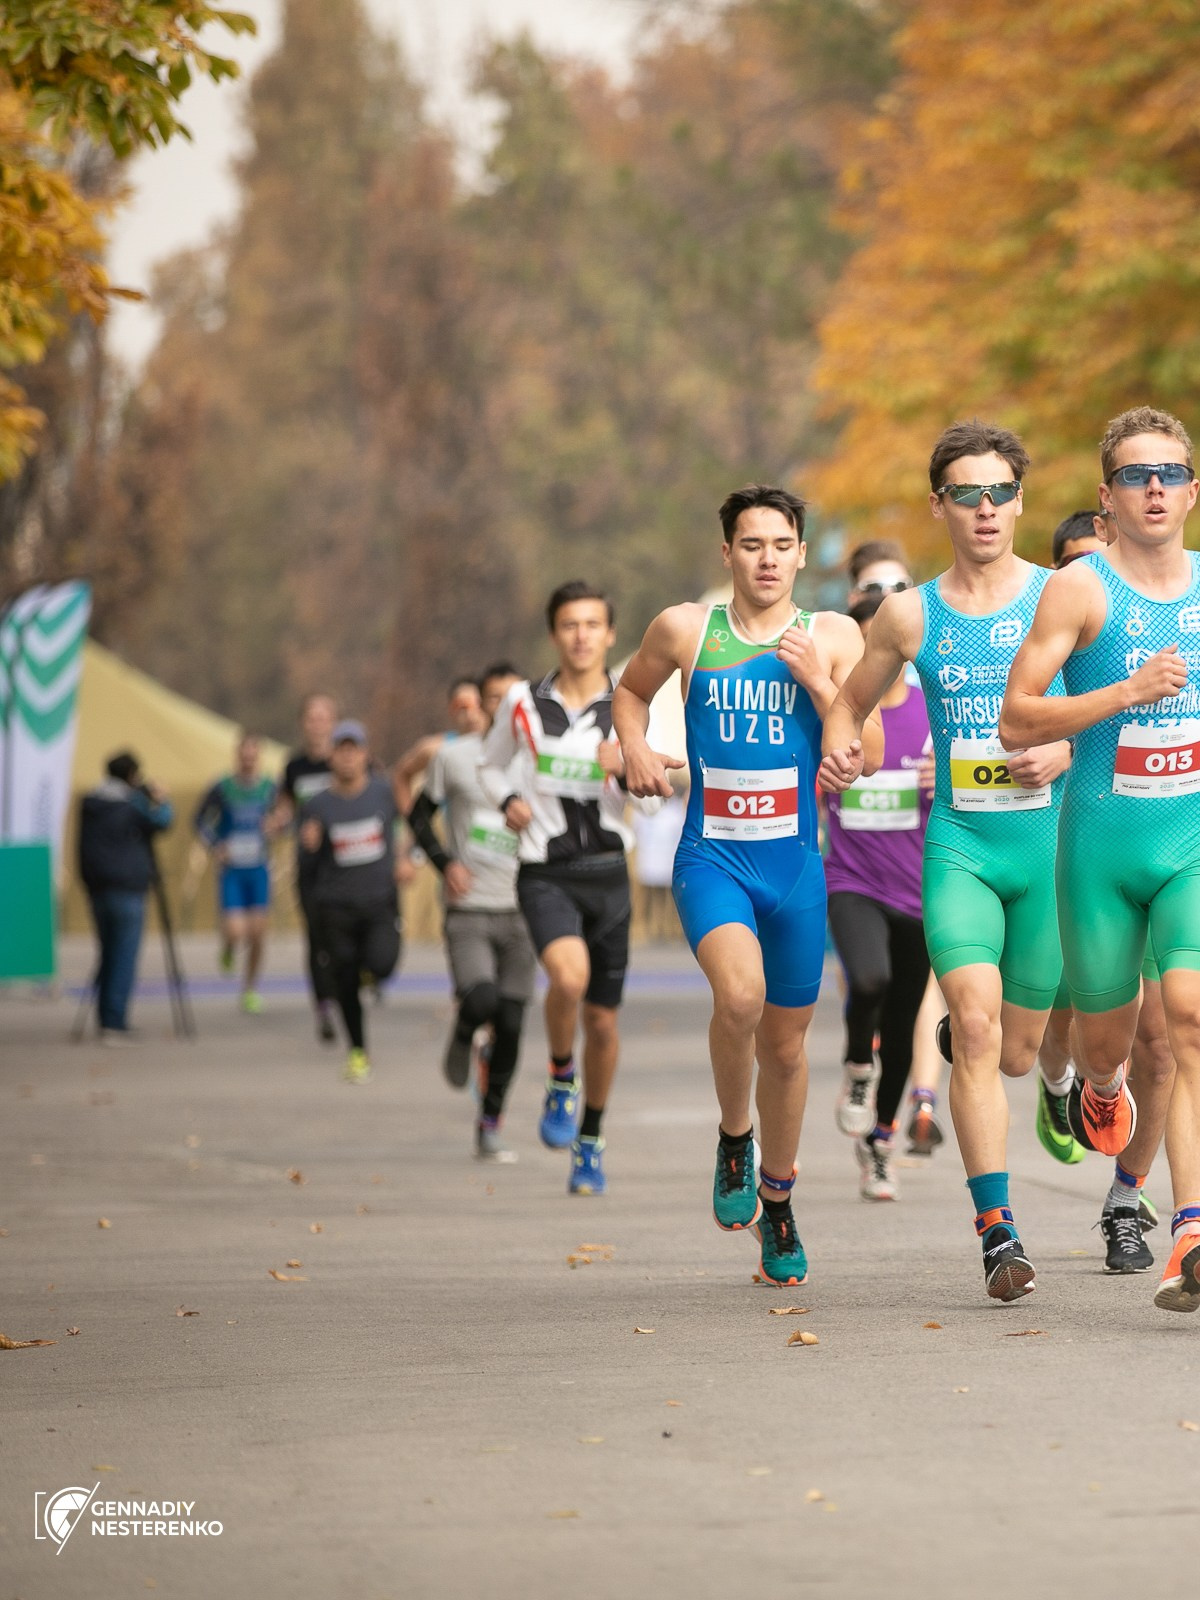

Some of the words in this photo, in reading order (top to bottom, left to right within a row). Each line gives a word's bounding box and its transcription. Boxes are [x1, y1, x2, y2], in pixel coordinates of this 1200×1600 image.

[705, 678, 797, 715] ALIMOV
[719, 712, 785, 745] UZB
[1145, 749, 1193, 773] 013
[973, 765, 1011, 785] 02
[727, 795, 776, 816] 012
